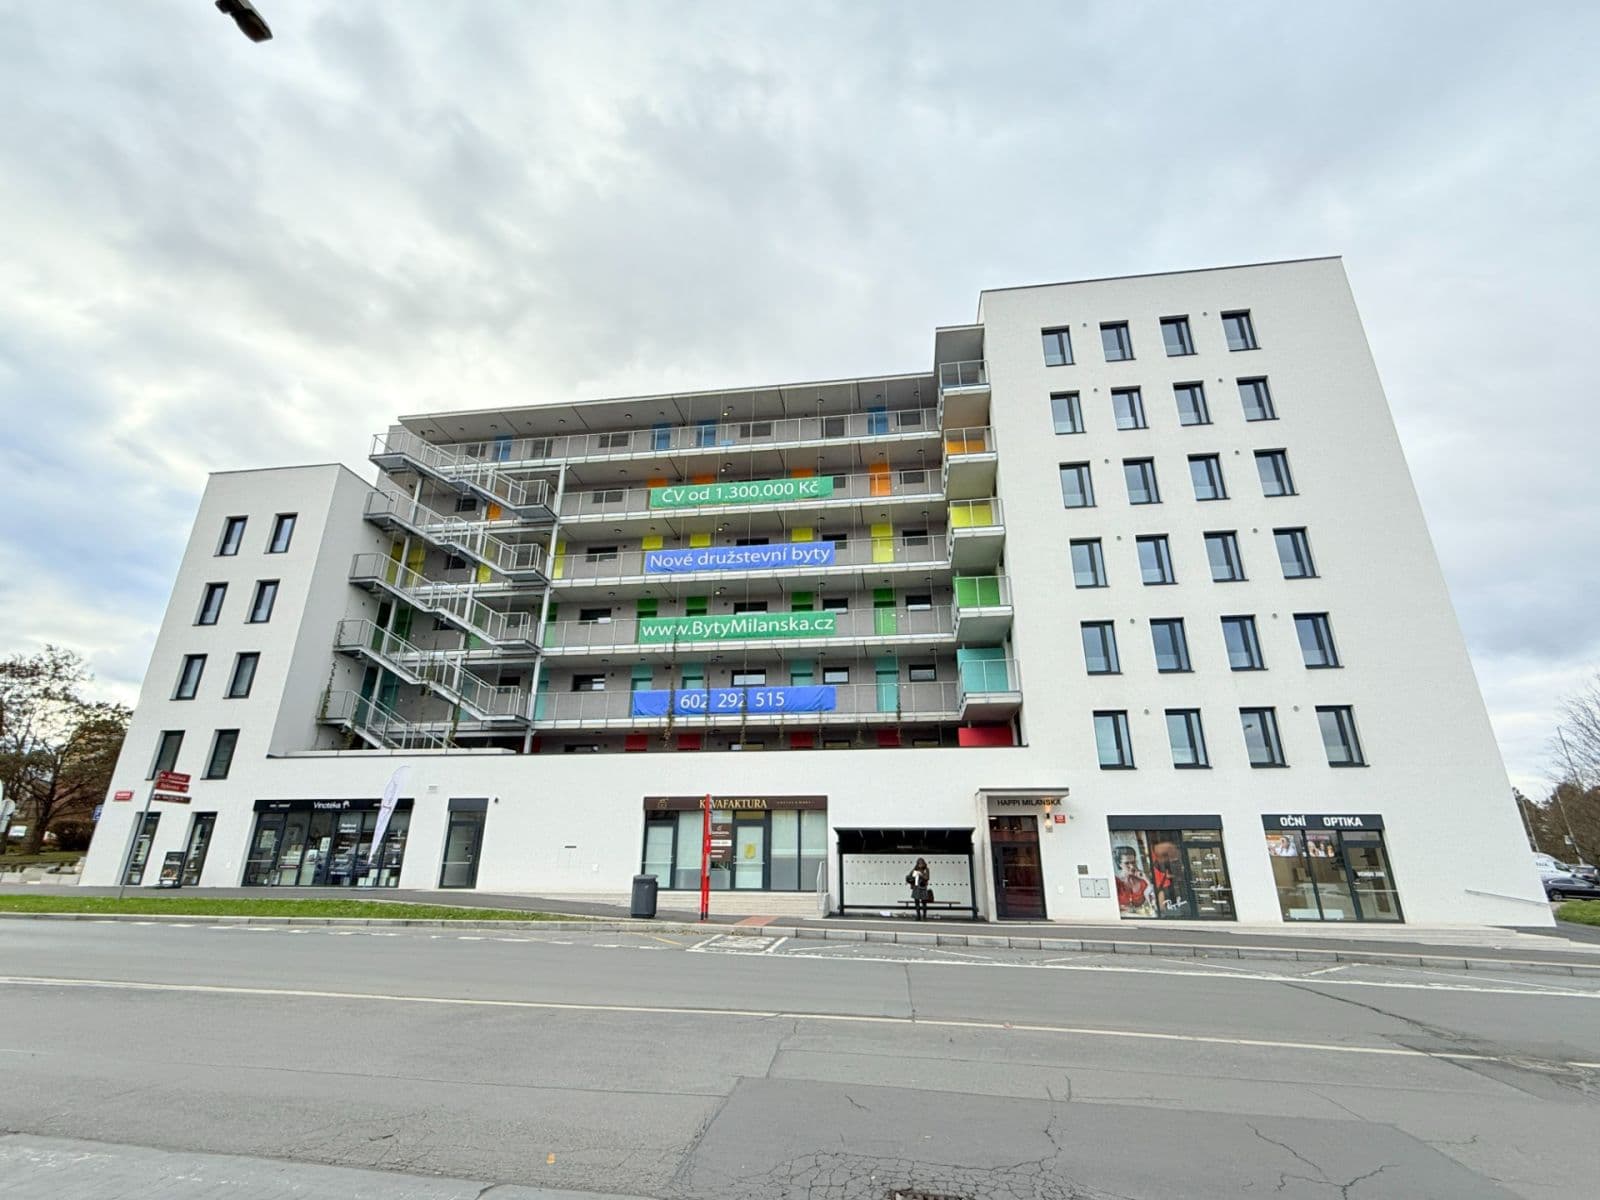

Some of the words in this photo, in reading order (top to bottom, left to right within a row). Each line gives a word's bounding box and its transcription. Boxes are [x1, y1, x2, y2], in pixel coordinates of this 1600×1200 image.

[661, 488, 685, 503] ČV
[688, 486, 710, 501] od
[715, 482, 794, 499] 1.300.000
[799, 480, 820, 495] Kč
[650, 552, 693, 567] Nové
[697, 547, 788, 566] družstevní
[792, 546, 830, 563] byty
[642, 616, 834, 638] www.BytyMilanska.cz
[680, 693, 708, 709] 602
[756, 691, 785, 707] 515
[699, 799, 767, 809] KVAFAKTURA
[997, 799, 1020, 807] HAPPI
[1280, 815, 1307, 827] OČNÍ
[1323, 816, 1363, 827] OPTIKA
